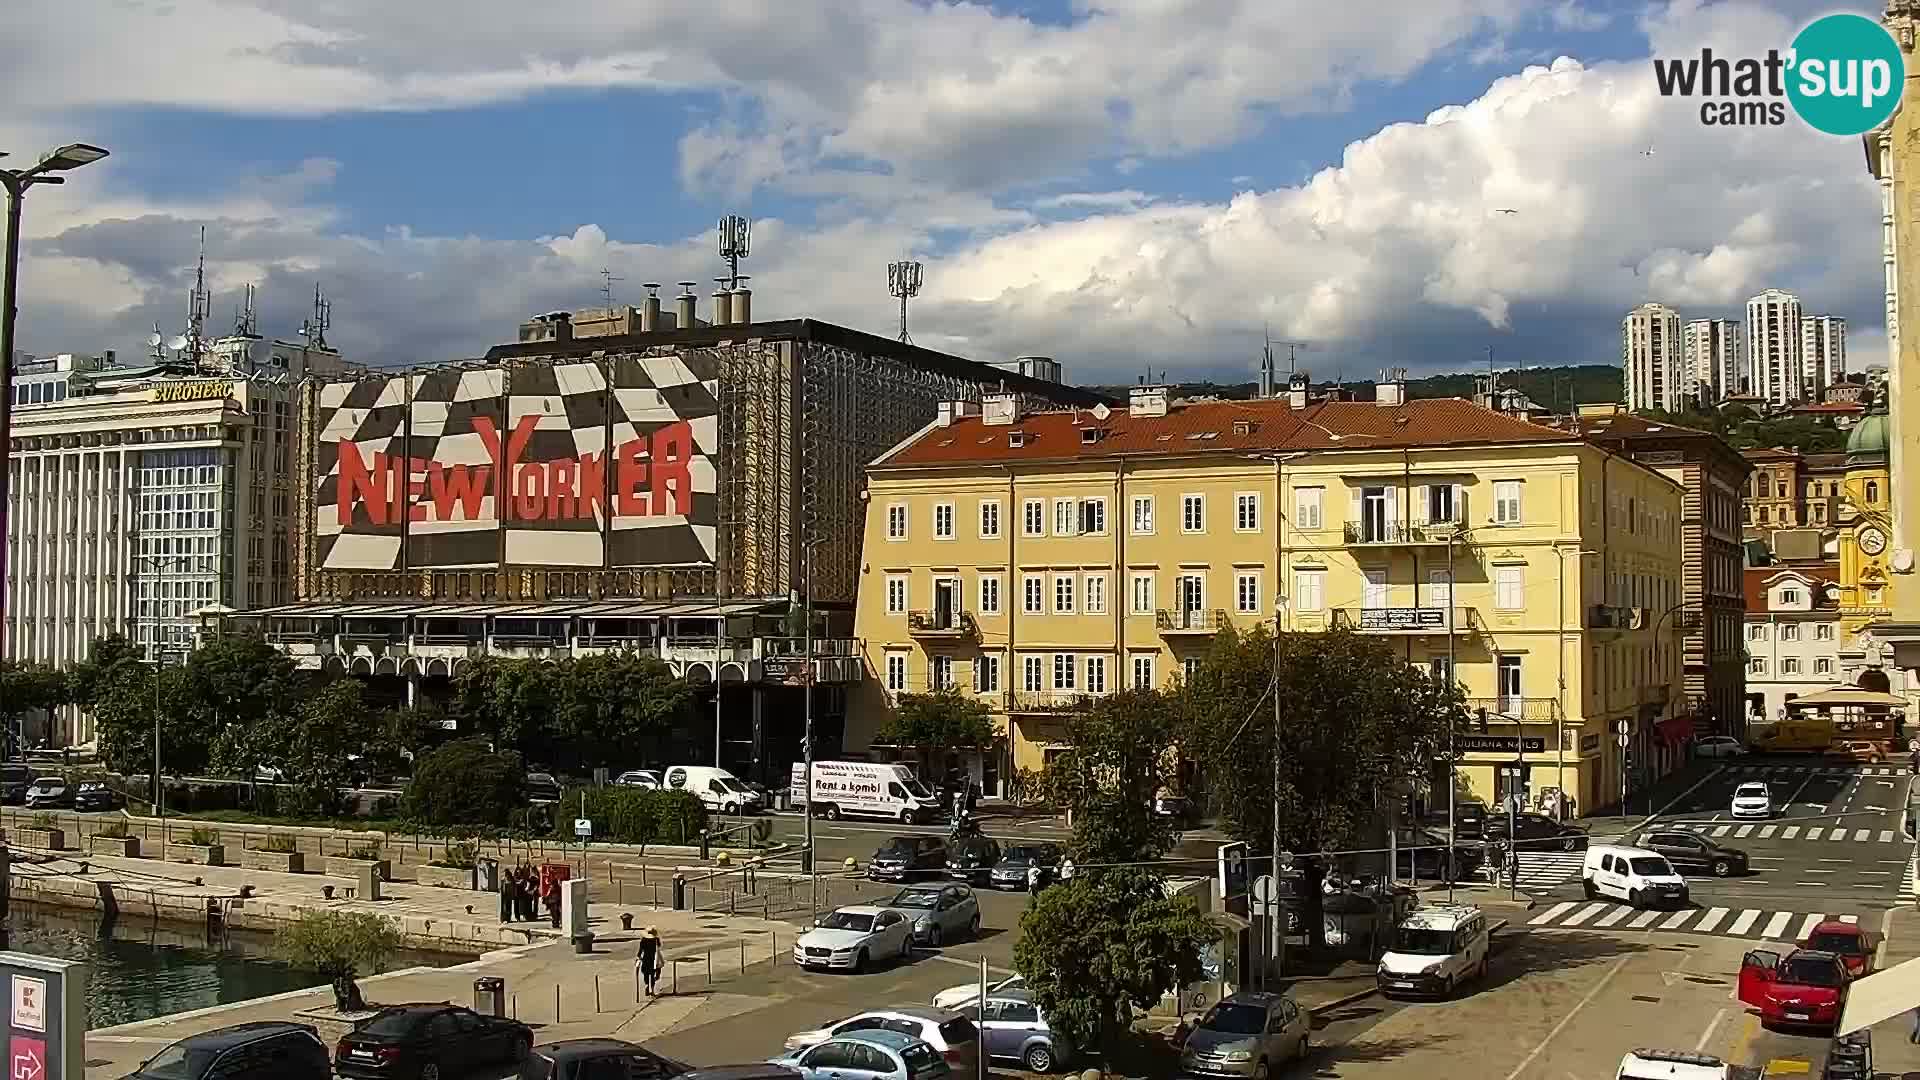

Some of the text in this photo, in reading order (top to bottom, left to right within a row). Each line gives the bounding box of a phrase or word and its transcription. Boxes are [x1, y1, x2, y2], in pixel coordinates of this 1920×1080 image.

[337, 414, 693, 526] NEW YORKER
[1458, 740, 1539, 749] JULIANA NAILS
[815, 779, 838, 791] Rent
[840, 783, 847, 791] a
